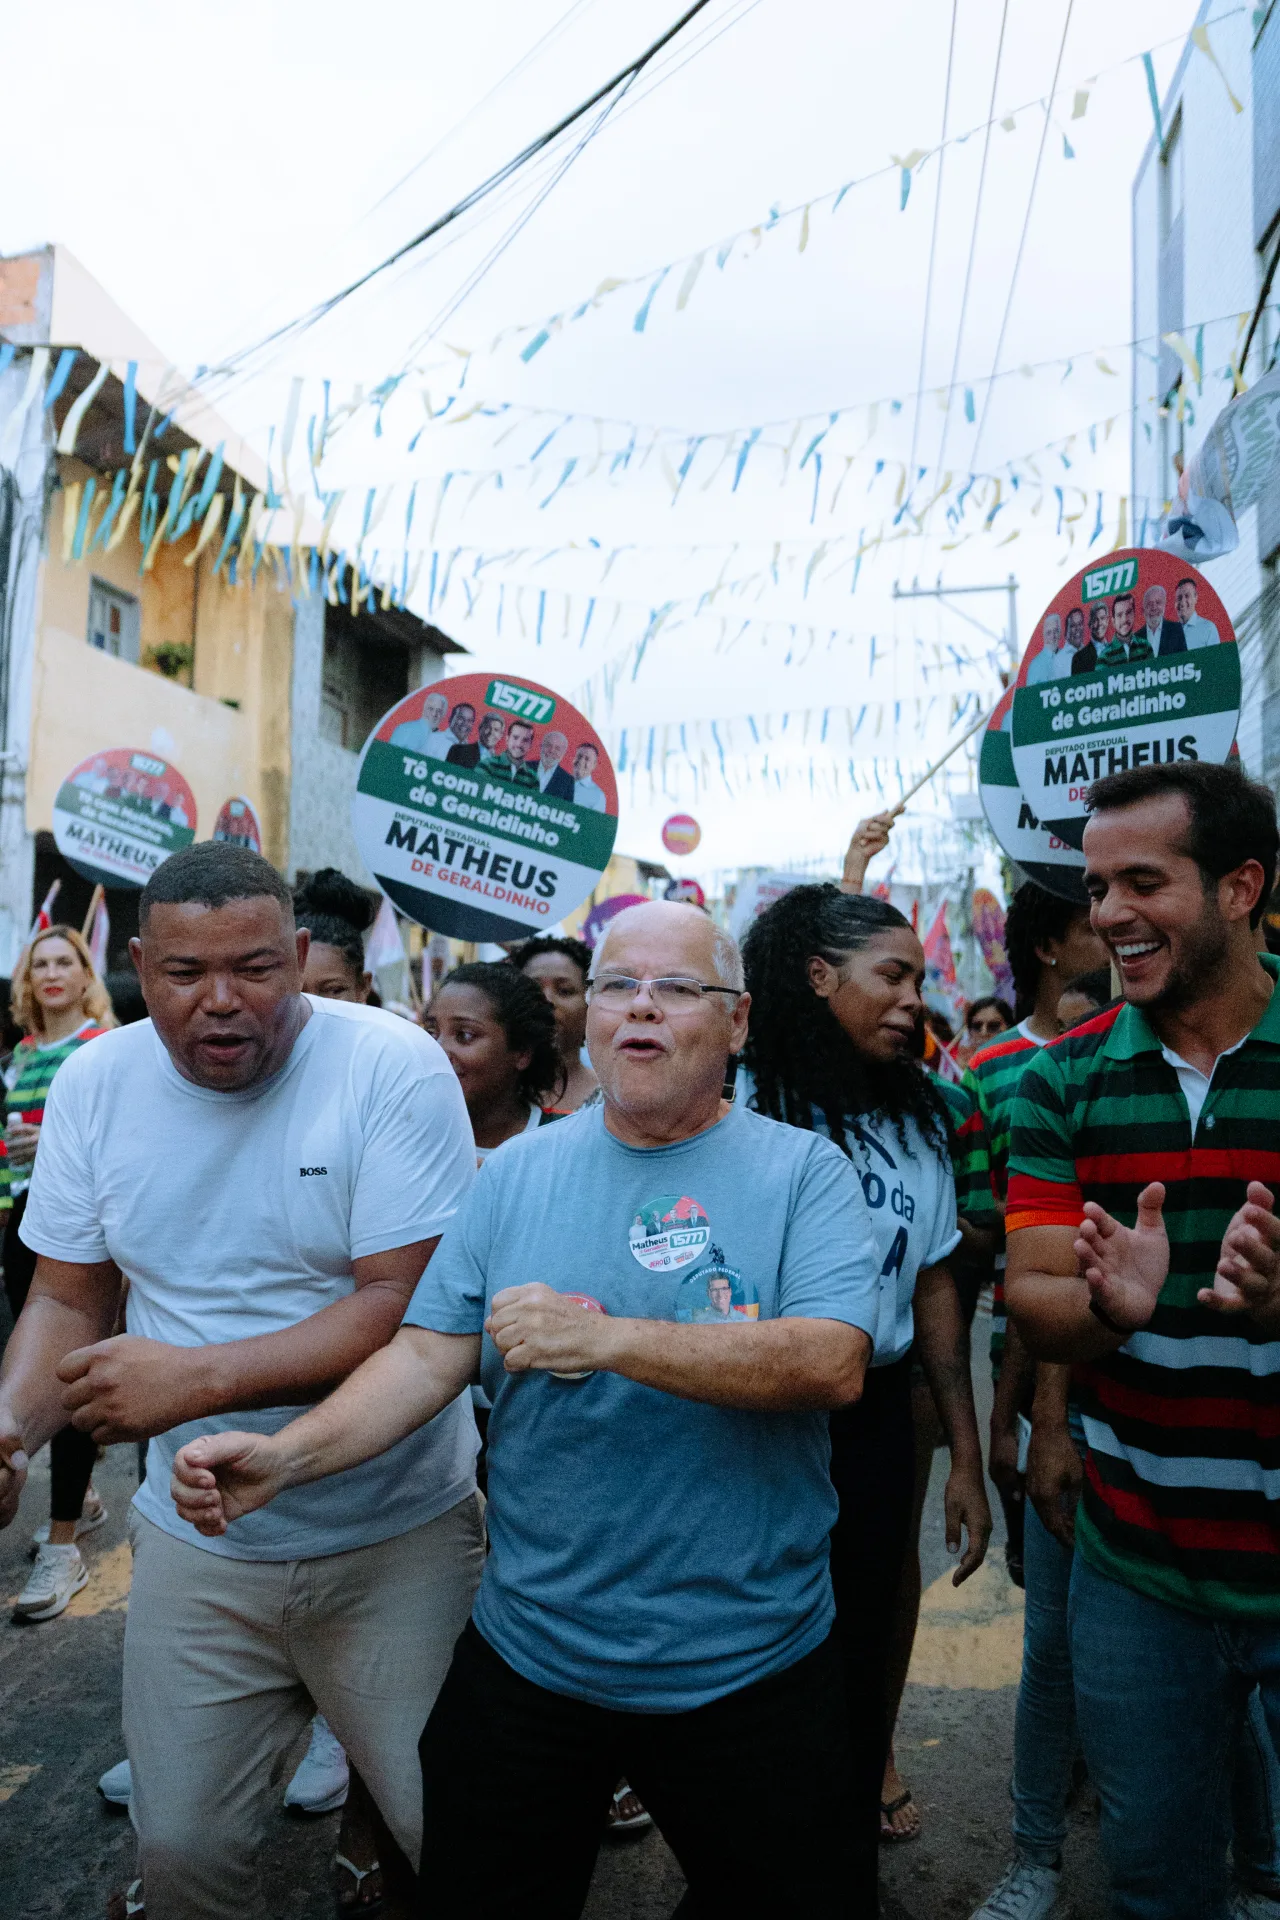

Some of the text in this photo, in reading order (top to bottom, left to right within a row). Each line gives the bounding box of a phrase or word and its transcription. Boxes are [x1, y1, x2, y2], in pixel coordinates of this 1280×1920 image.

[1085, 561, 1135, 599] 15777
[491, 681, 553, 720] 15777
[1040, 663, 1202, 709] Tô com Matheus,
[1052, 691, 1186, 731] de Geraldinho
[1045, 736, 1128, 756] DEPUTADO ESTADUAL
[402, 756, 581, 834] Tô com Matheus,
[394, 812, 492, 848] DEPUTADO ESTADUAL
[409, 785, 559, 847] de Geraldinho
[65, 823, 159, 869] MATHEUS
[385, 820, 558, 898] MATHEUS
[411, 859, 550, 915] DE GERALDINHO
[299, 1166, 328, 1177] BOSS
[891, 1180, 916, 1224] da
[632, 1236, 668, 1250] Matheus
[671, 1231, 704, 1247] 15777
[689, 1267, 741, 1283] DEPUTADO FEDERAL
